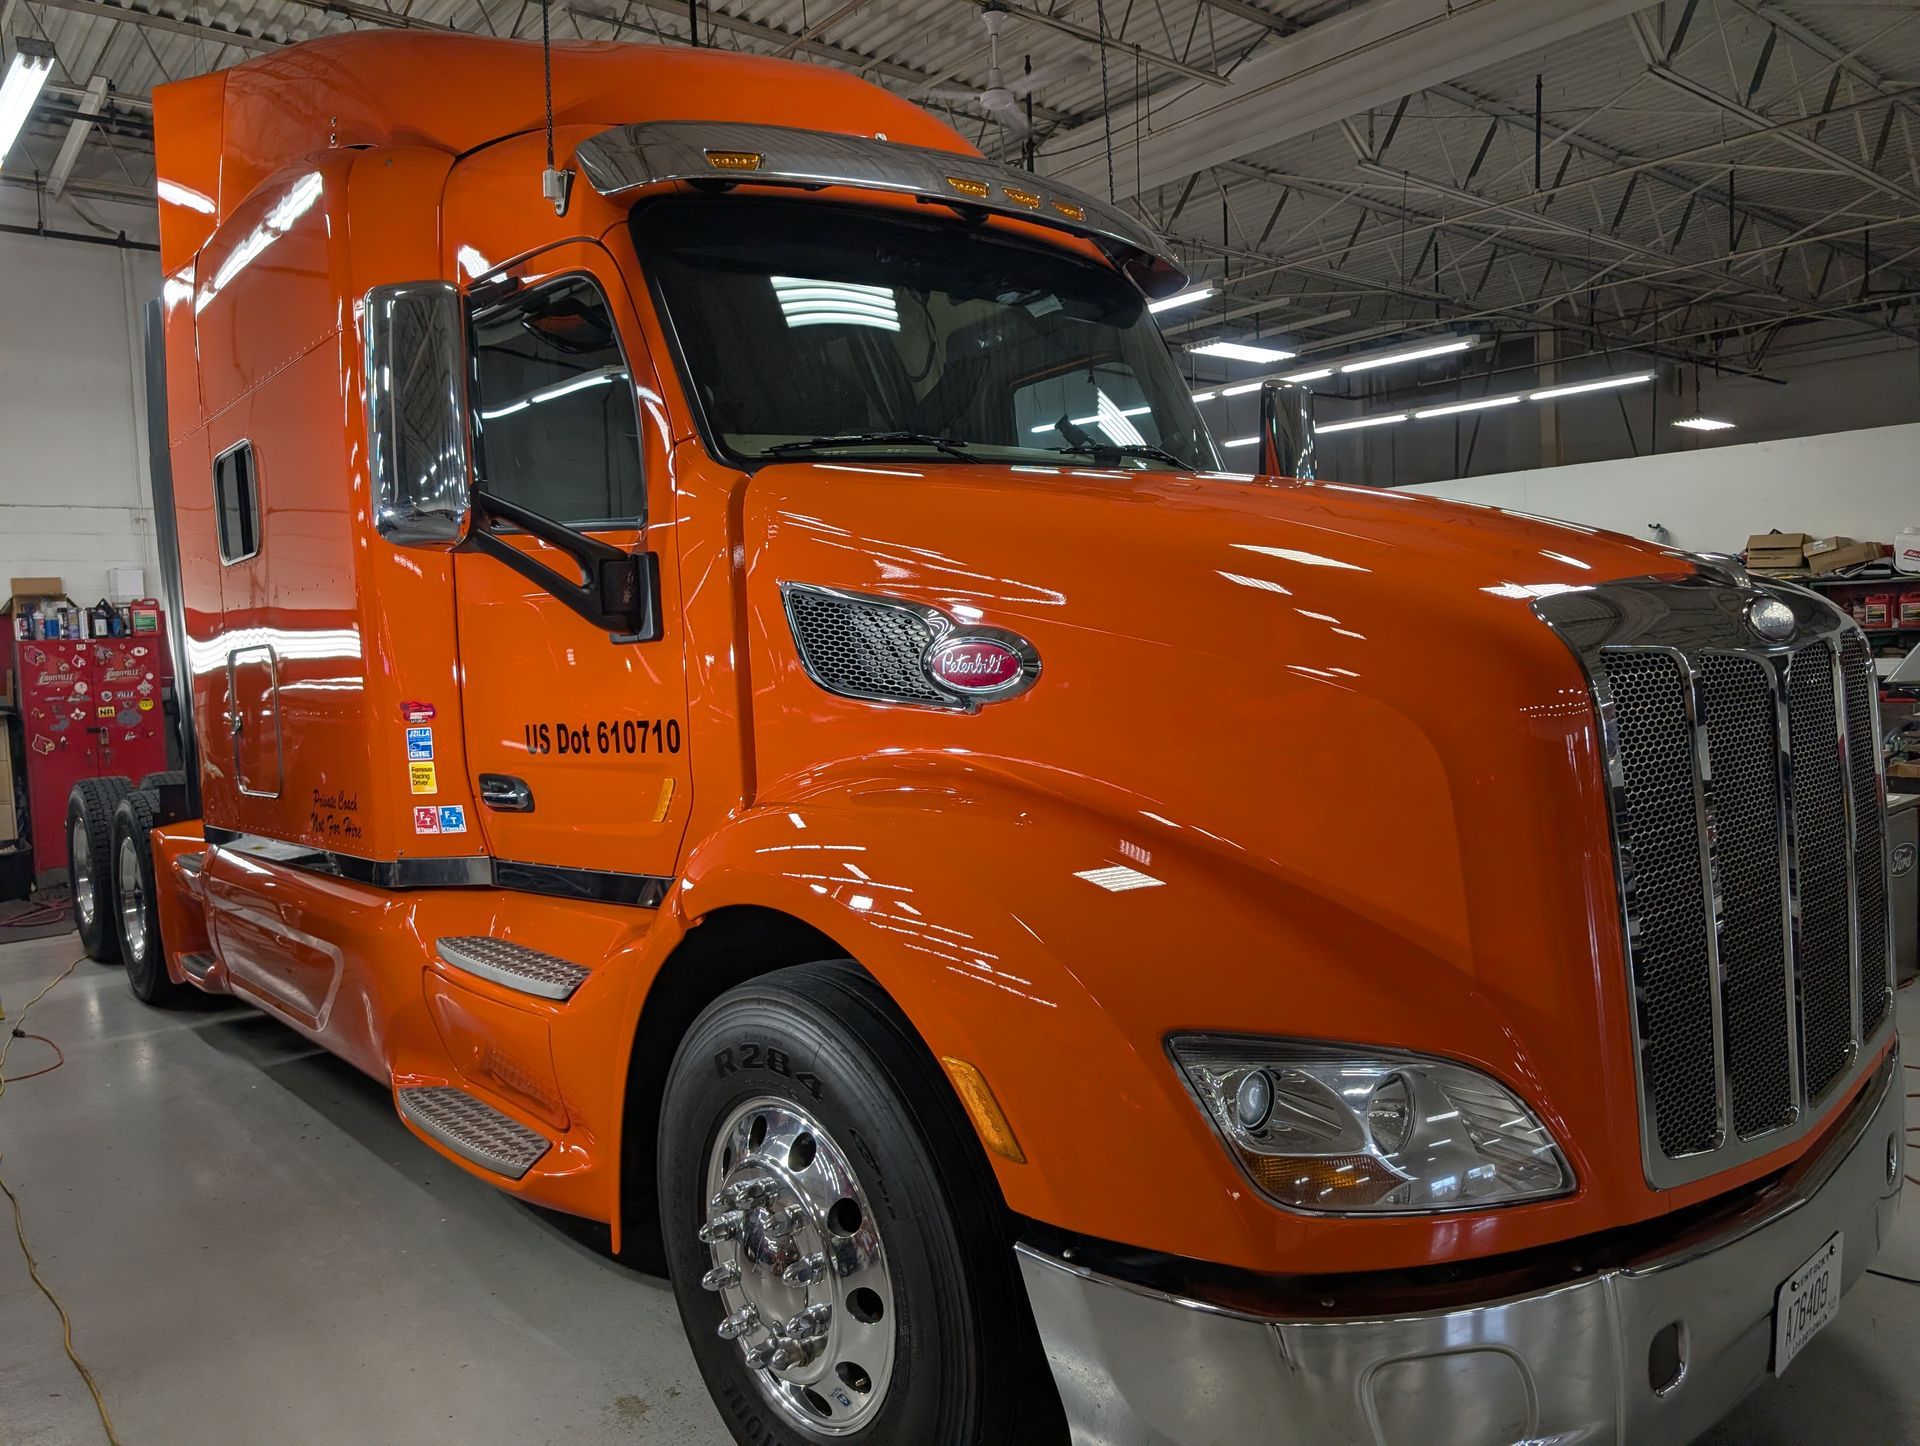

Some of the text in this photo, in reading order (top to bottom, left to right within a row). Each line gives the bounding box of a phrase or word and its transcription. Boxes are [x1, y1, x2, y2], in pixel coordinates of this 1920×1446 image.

[942, 650, 1009, 675] Peterbilt
[525, 719, 681, 754] US Dot 610710
[313, 788, 358, 812] Private Coach
[311, 812, 362, 839] Not For Hire
[1891, 846, 1913, 873] Ford
[713, 1041, 824, 1104] R284
[1784, 1269, 1829, 1348] A76409
